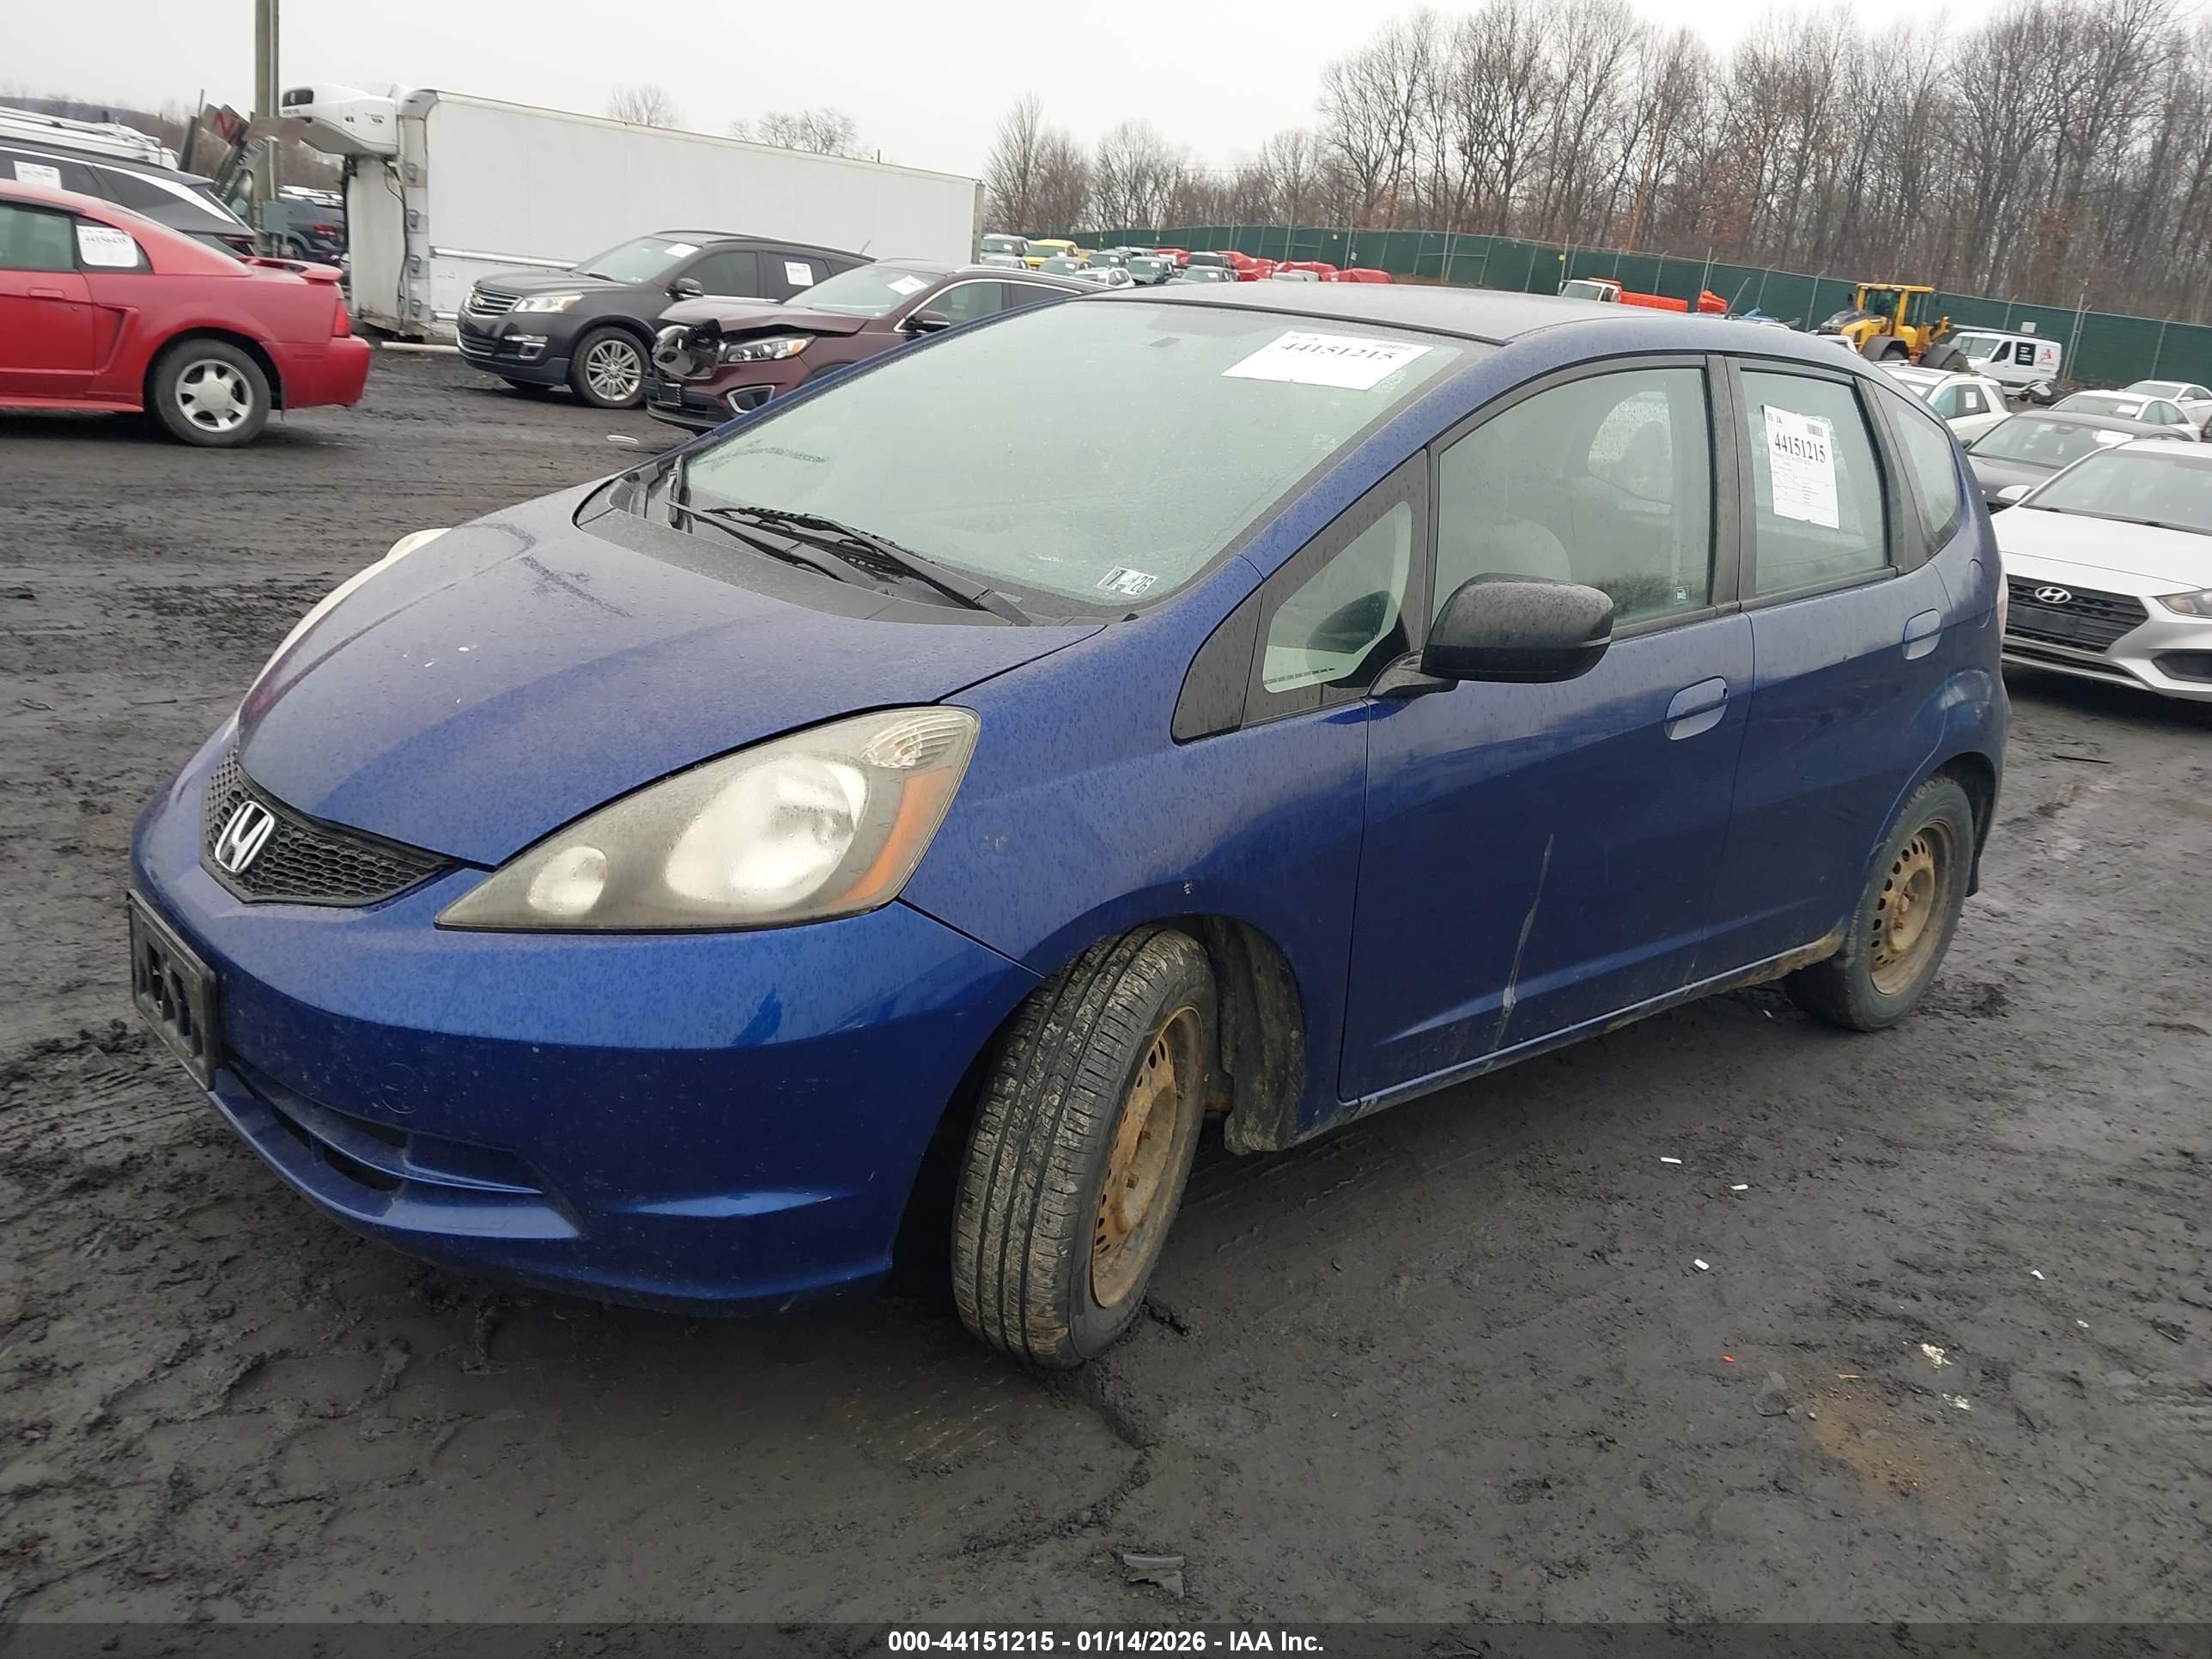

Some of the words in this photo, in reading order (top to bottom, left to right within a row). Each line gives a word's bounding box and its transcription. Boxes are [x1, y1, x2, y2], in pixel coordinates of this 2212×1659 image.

[1279, 342, 1400, 361] 44151215
[1775, 432, 1826, 464] 44151215
[1129, 575, 1154, 593] 26
